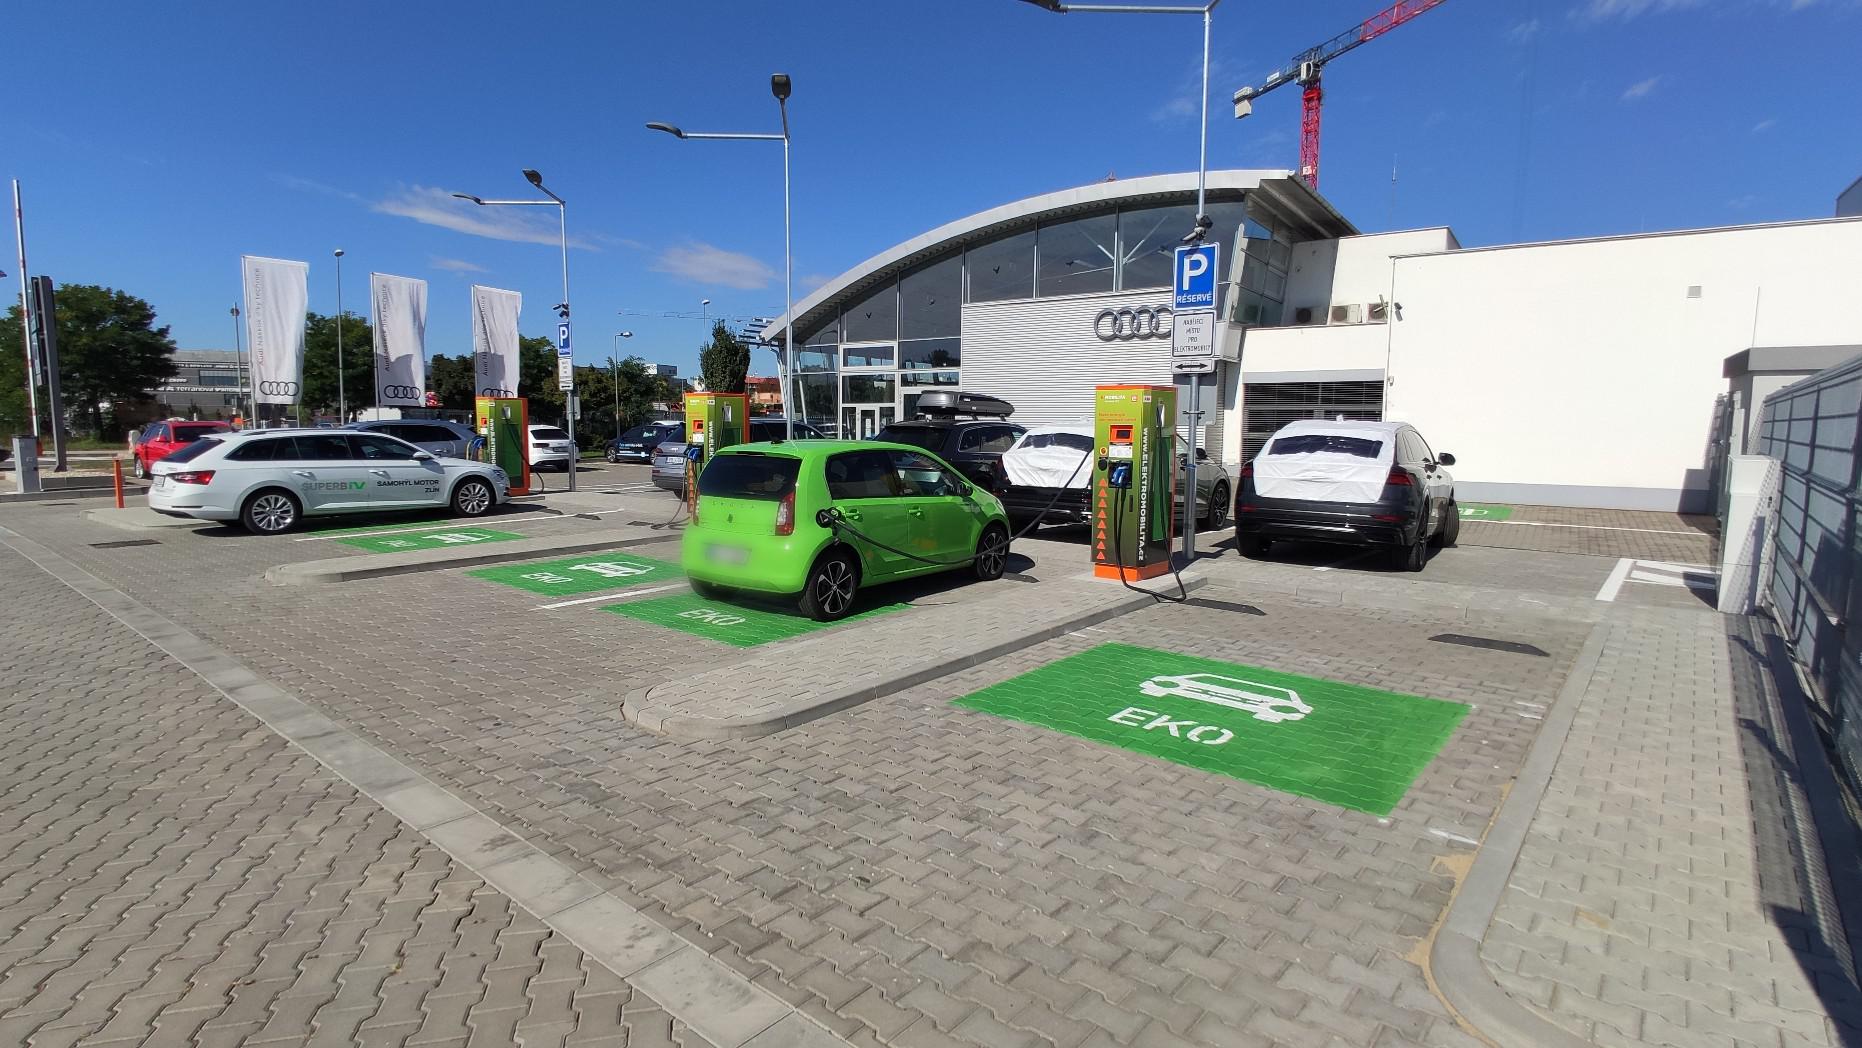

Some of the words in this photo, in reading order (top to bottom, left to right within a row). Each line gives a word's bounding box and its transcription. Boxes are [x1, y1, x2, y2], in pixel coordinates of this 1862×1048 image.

[1182, 253, 1208, 291] P
[1176, 291, 1213, 304] RÉSERVÉ
[559, 326, 569, 347] P
[303, 482, 348, 491] SUPERB
[520, 571, 573, 584] EKO
[676, 608, 746, 626] EKO
[1106, 706, 1235, 745] EKO
